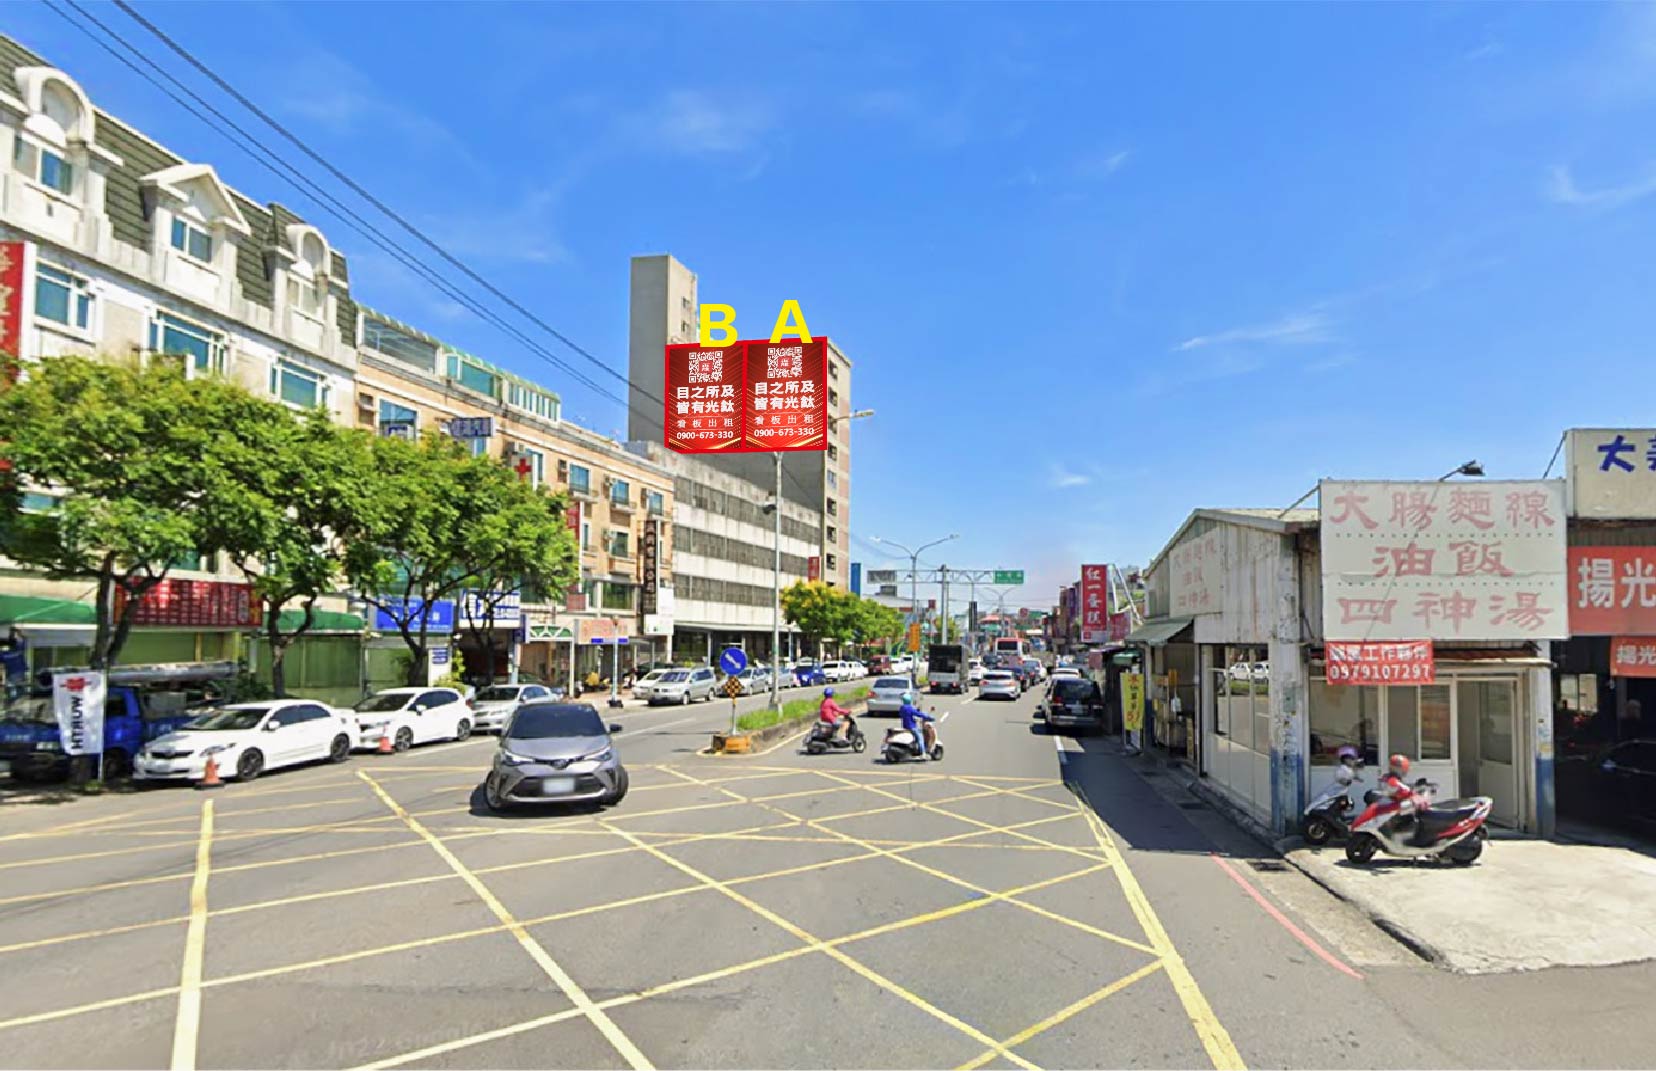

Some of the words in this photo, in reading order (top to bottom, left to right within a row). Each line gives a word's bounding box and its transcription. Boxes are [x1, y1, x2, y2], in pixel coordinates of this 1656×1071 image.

[676, 384, 735, 399] 目之所及
[755, 380, 815, 395] 目之所及
[676, 430, 734, 439] 0900-673-330
[754, 427, 815, 437] 0900-673-330
[1330, 488, 1555, 531] 大腸麵線
[1372, 540, 1514, 577] 油飯
[1338, 590, 1554, 633] 四神湯
